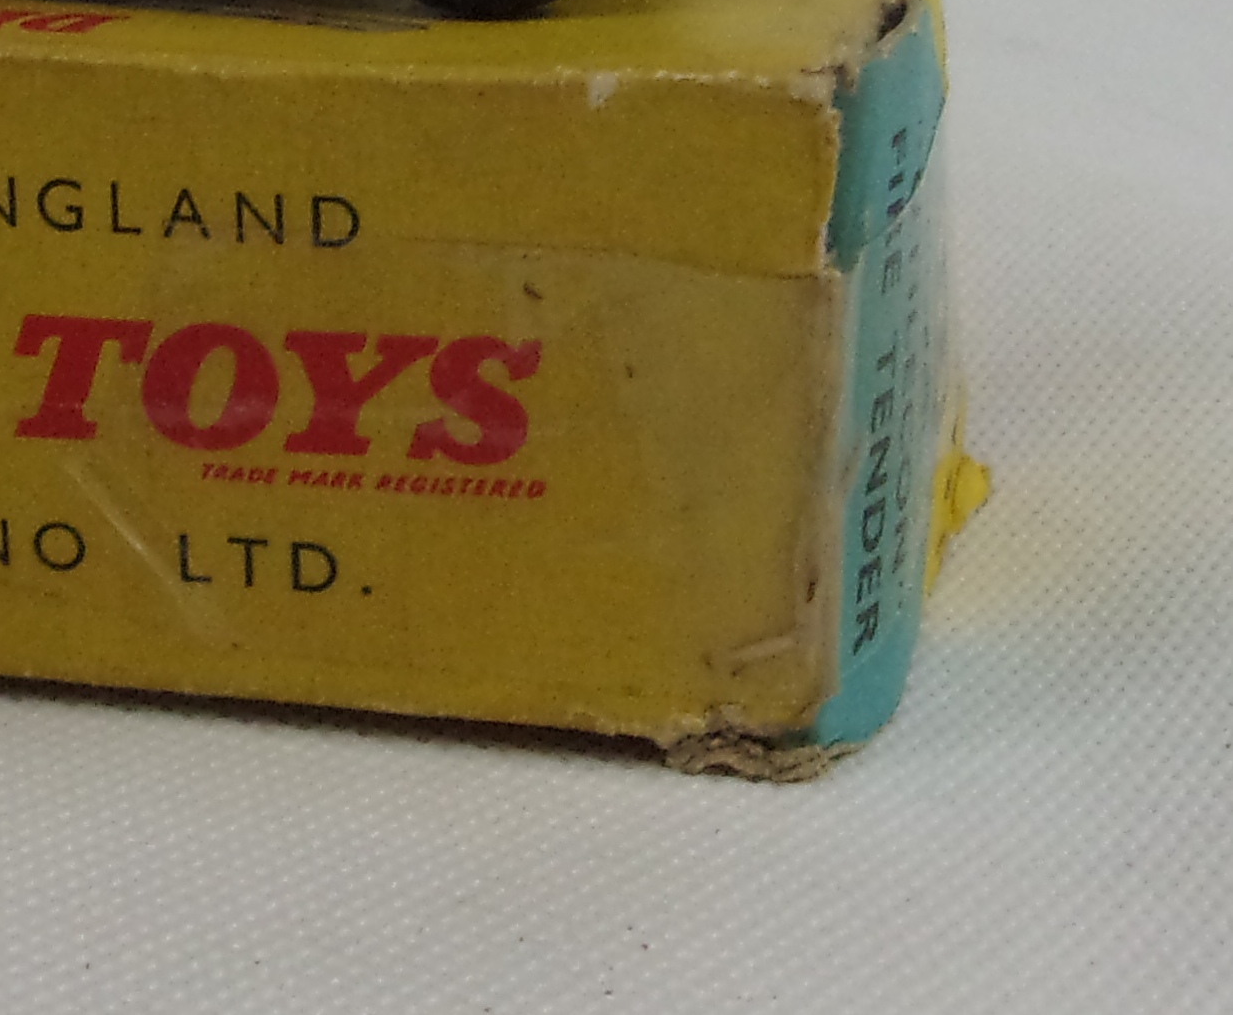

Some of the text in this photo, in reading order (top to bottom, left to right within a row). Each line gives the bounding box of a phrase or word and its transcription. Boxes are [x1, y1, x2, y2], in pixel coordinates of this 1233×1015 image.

[14, 314, 542, 465] TOYS
[201, 463, 547, 498] TRADE MARK REGISTERED
[852, 329, 897, 658] TENDER
[178, 533, 373, 596] LTD.
